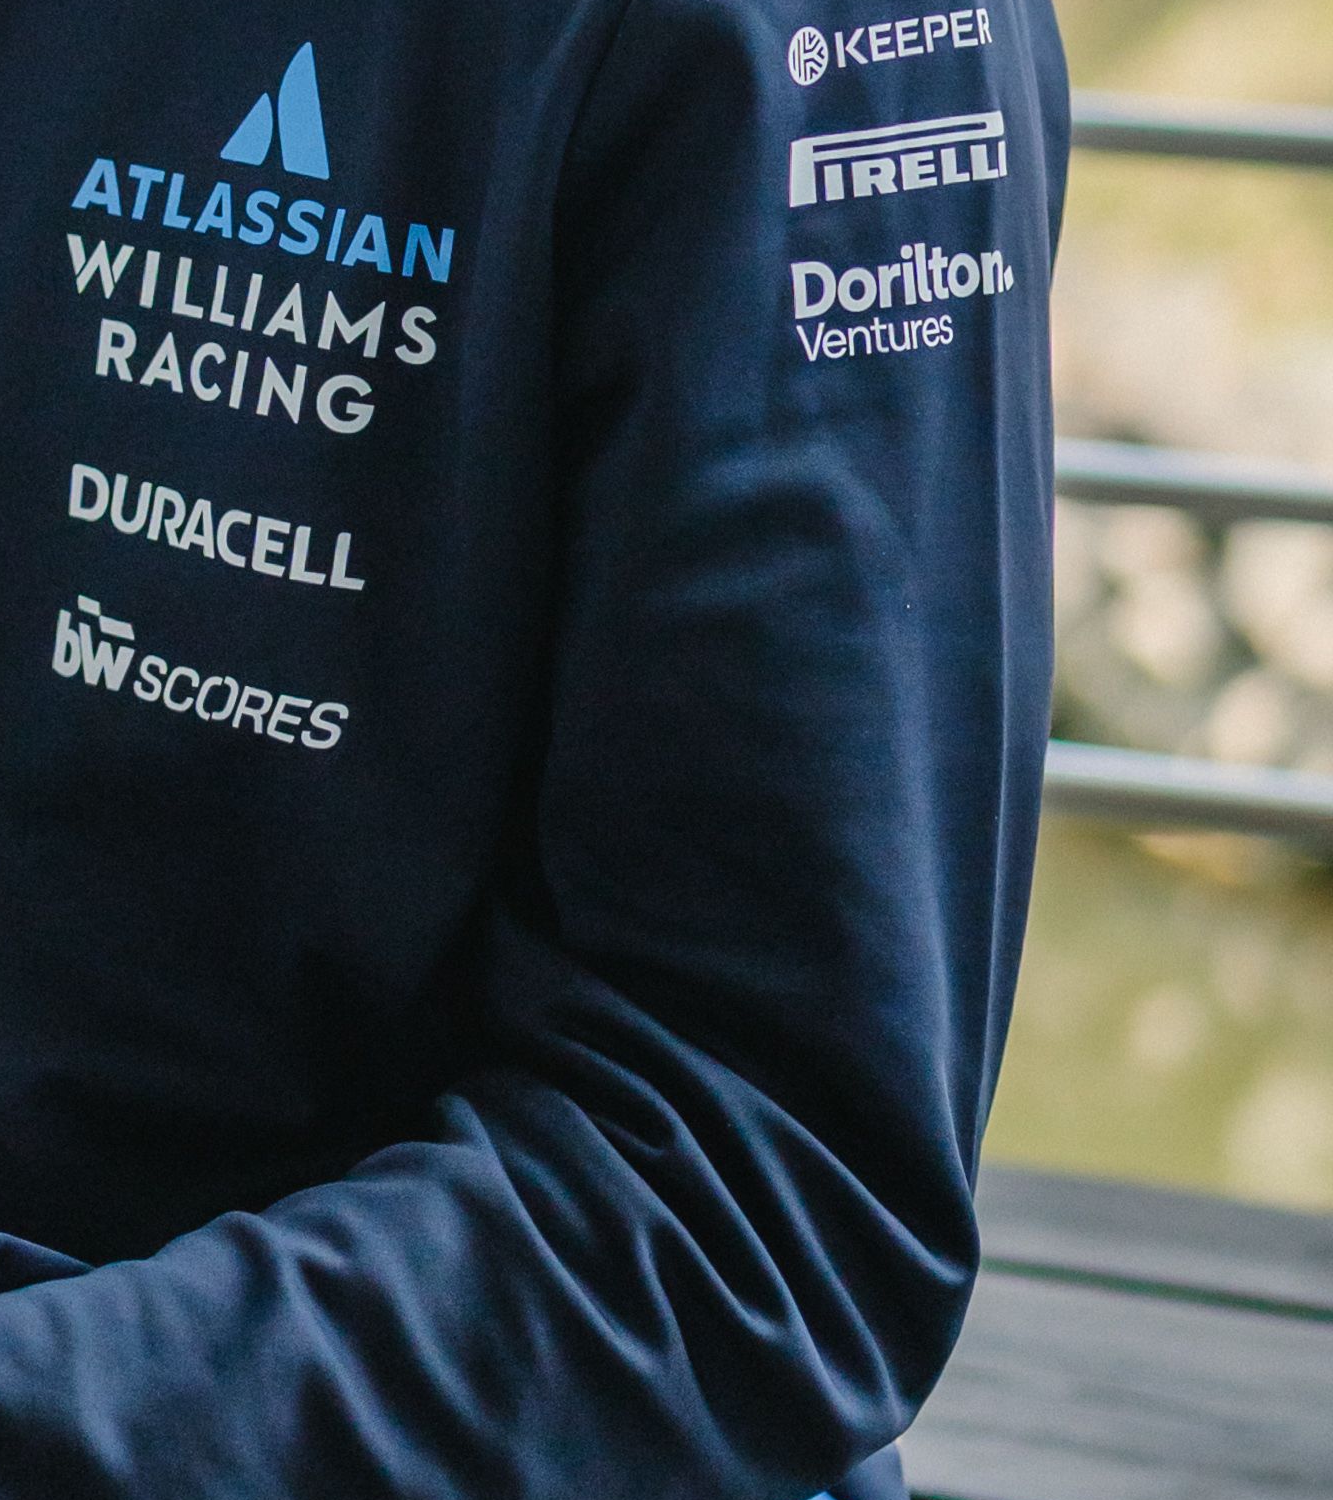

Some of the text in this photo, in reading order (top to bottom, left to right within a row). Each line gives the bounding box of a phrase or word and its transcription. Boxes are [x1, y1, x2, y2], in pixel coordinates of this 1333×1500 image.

[834, 8, 993, 68] KEEPER
[789, 110, 1008, 208] PIRELLI
[71, 157, 455, 284] ATLASSIAN
[66, 233, 438, 366] WILLIAMS
[795, 313, 954, 362] Ventures
[95, 318, 375, 435] RACING
[68, 463, 366, 591] DURACELL
